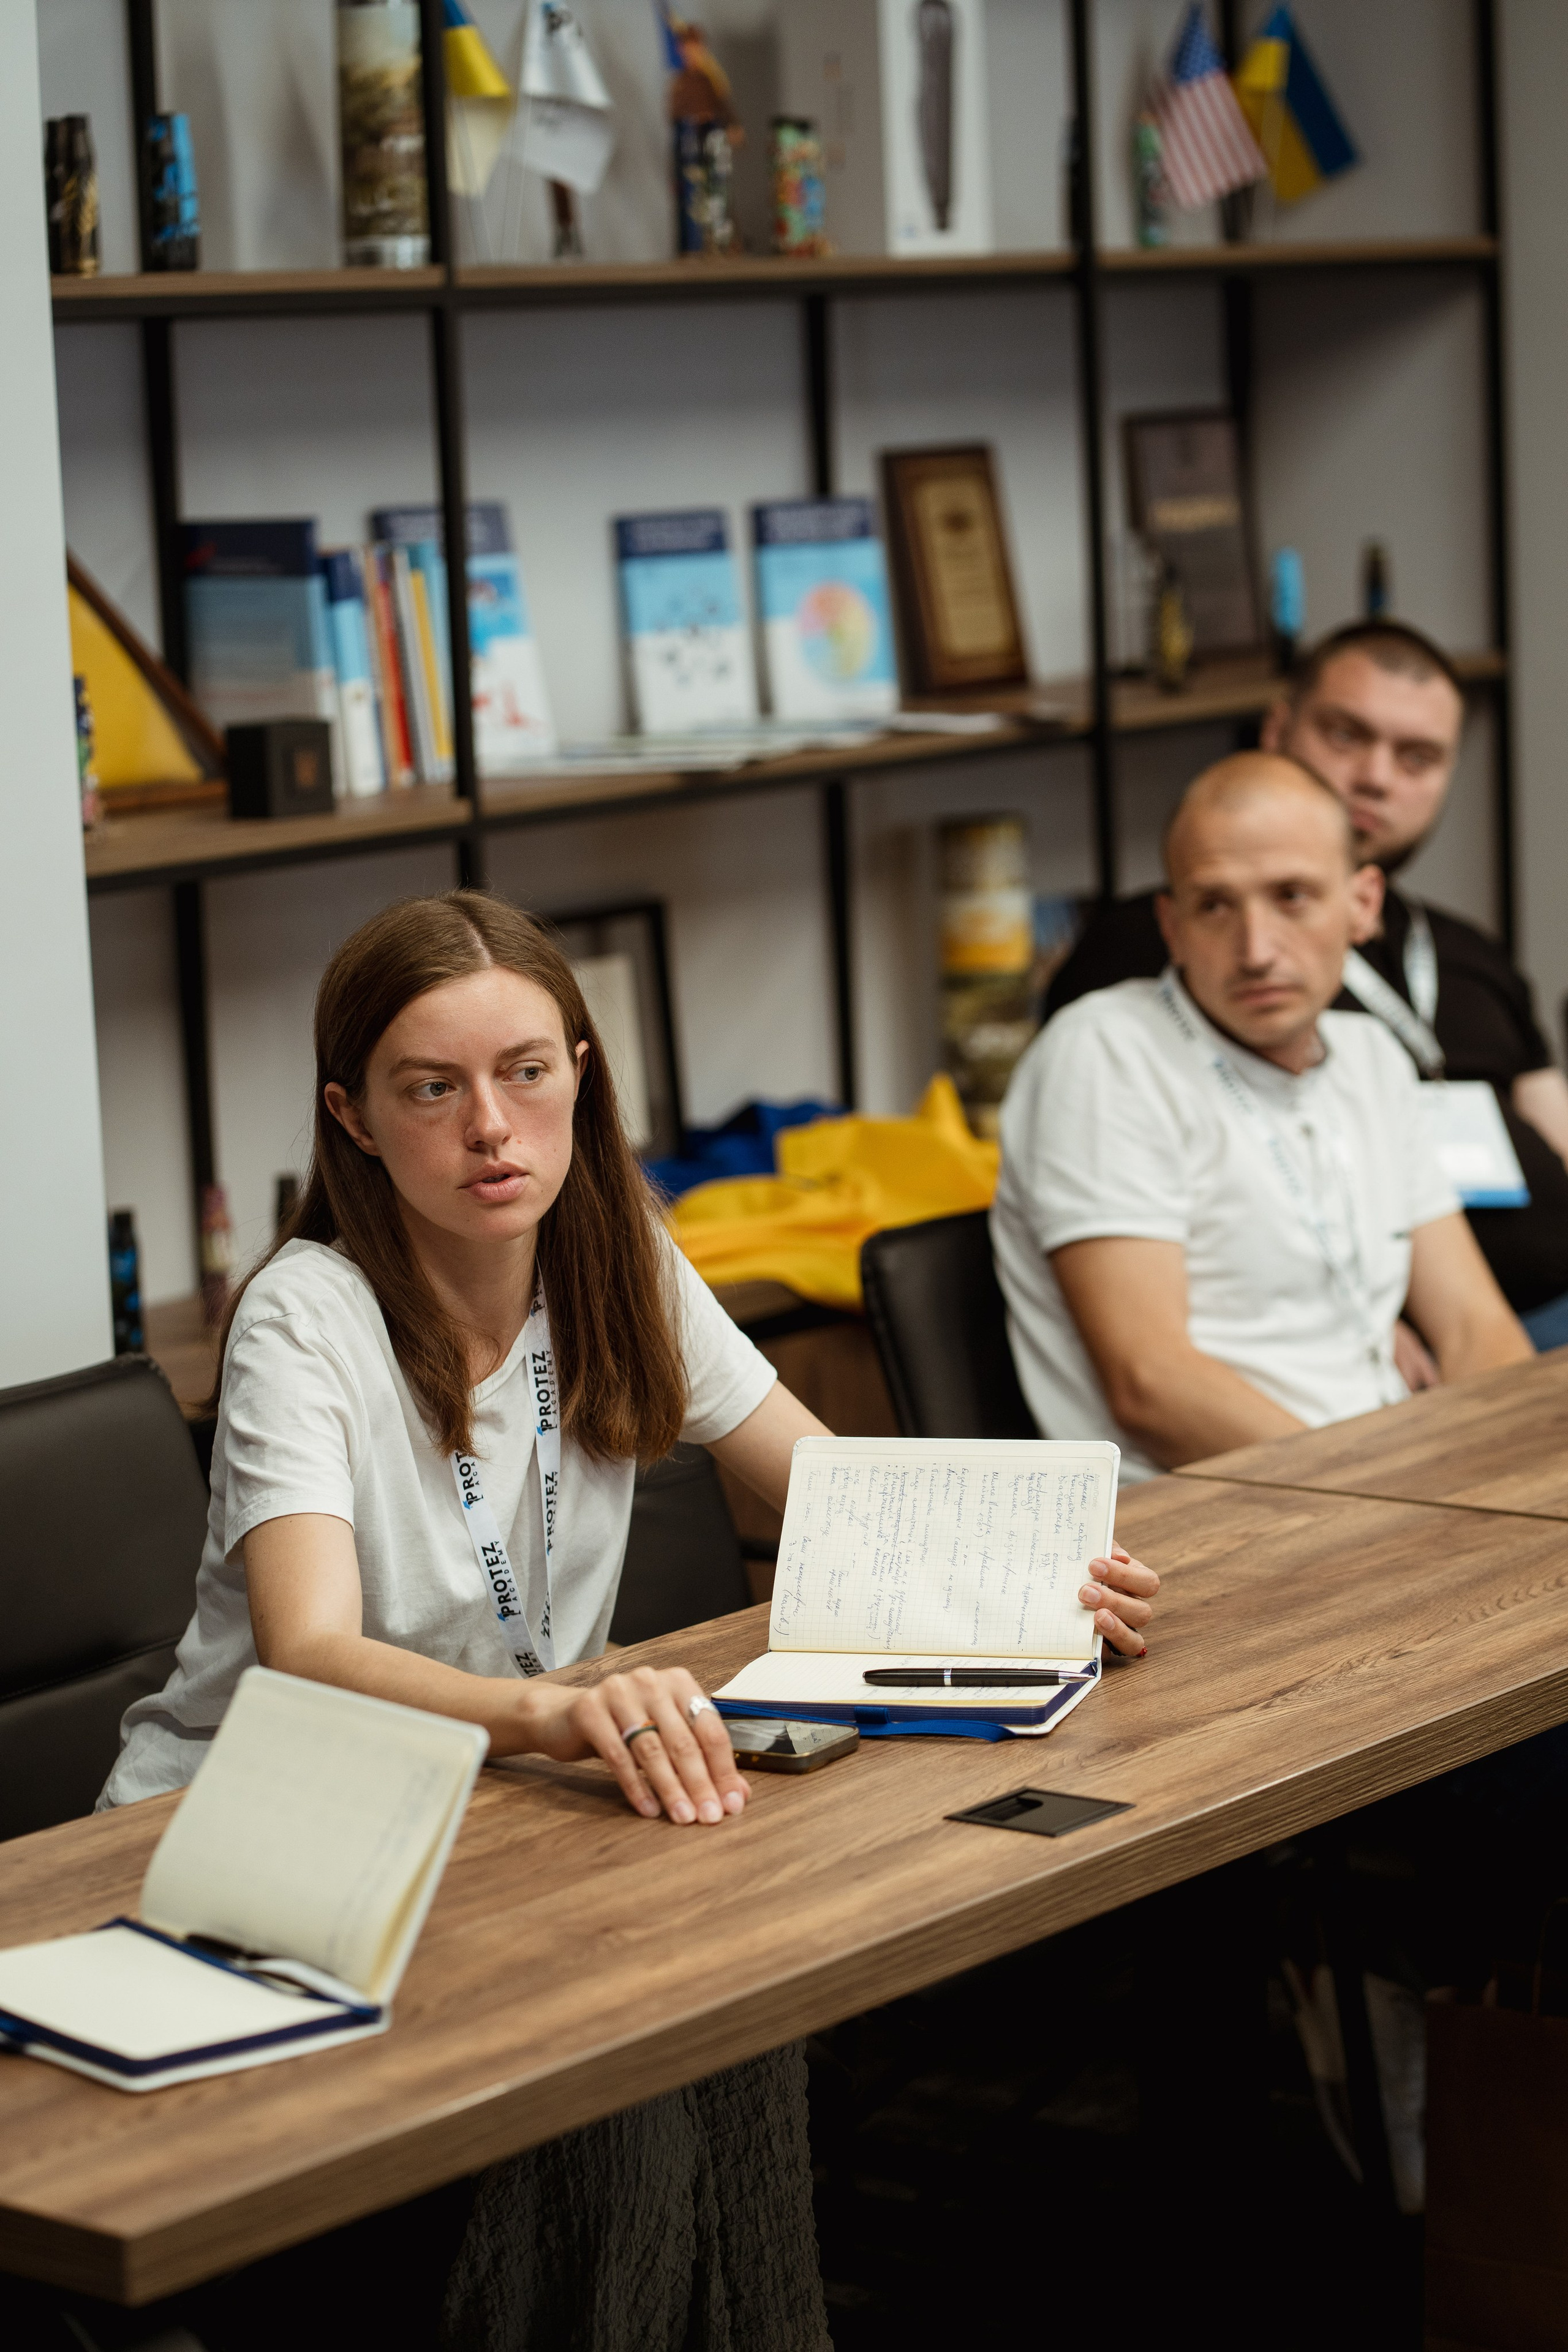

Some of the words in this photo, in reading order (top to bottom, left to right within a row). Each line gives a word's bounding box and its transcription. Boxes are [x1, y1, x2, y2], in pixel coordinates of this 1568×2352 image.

[532, 1350, 554, 1431] PROTEZ
[546, 1349, 557, 1414] ACADEMY
[455, 1452, 478, 1505] PROT
[545, 1471, 554, 1551] PROTEZ
[481, 1542, 514, 1617] PROTEZ
[494, 1540, 518, 1602] ACADEMY
[515, 1653, 538, 1677] TEZ
